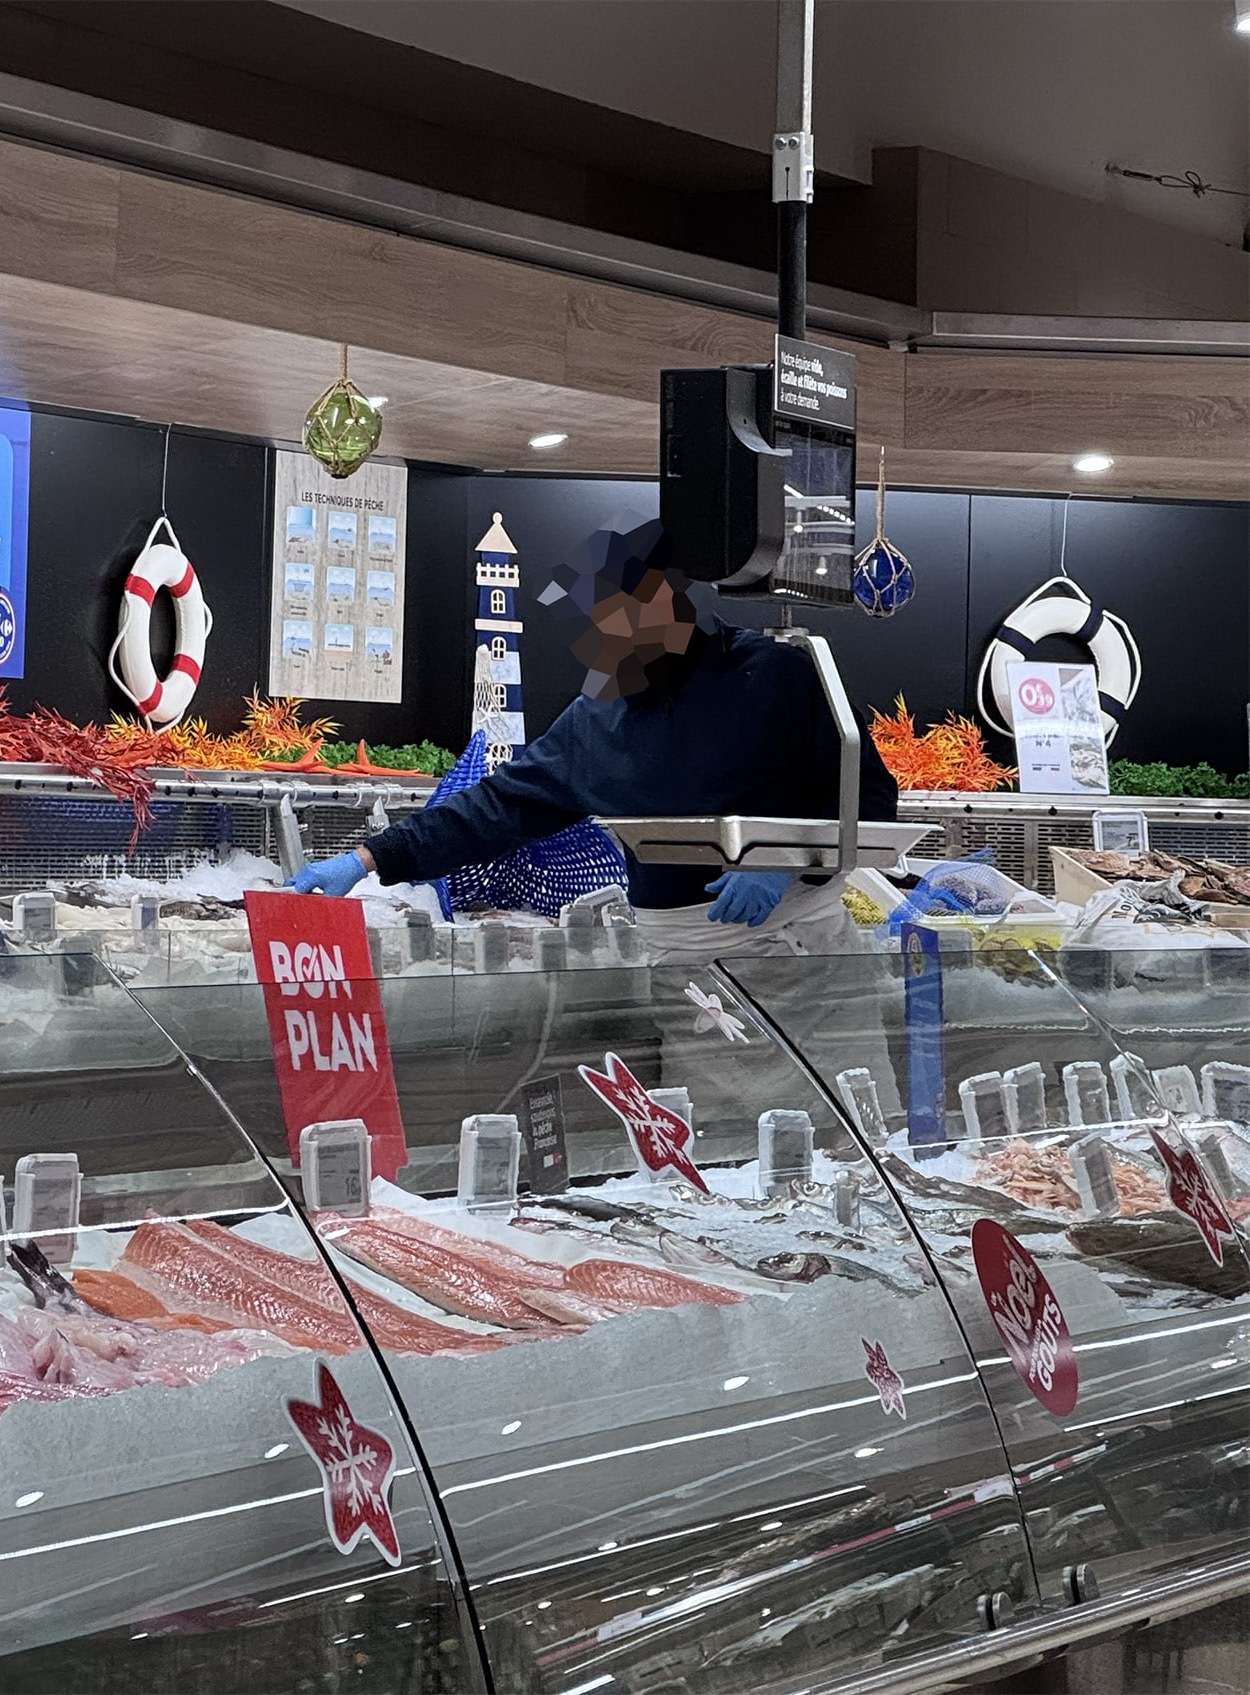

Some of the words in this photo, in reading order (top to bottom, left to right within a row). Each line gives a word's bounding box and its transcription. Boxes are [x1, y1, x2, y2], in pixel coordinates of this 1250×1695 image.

[301, 491, 313, 503] LES
[314, 493, 353, 508] TECHNIQUES
[355, 497, 363, 509] DE
[269, 941, 352, 999] BON
[284, 1009, 379, 1073] PLAN
